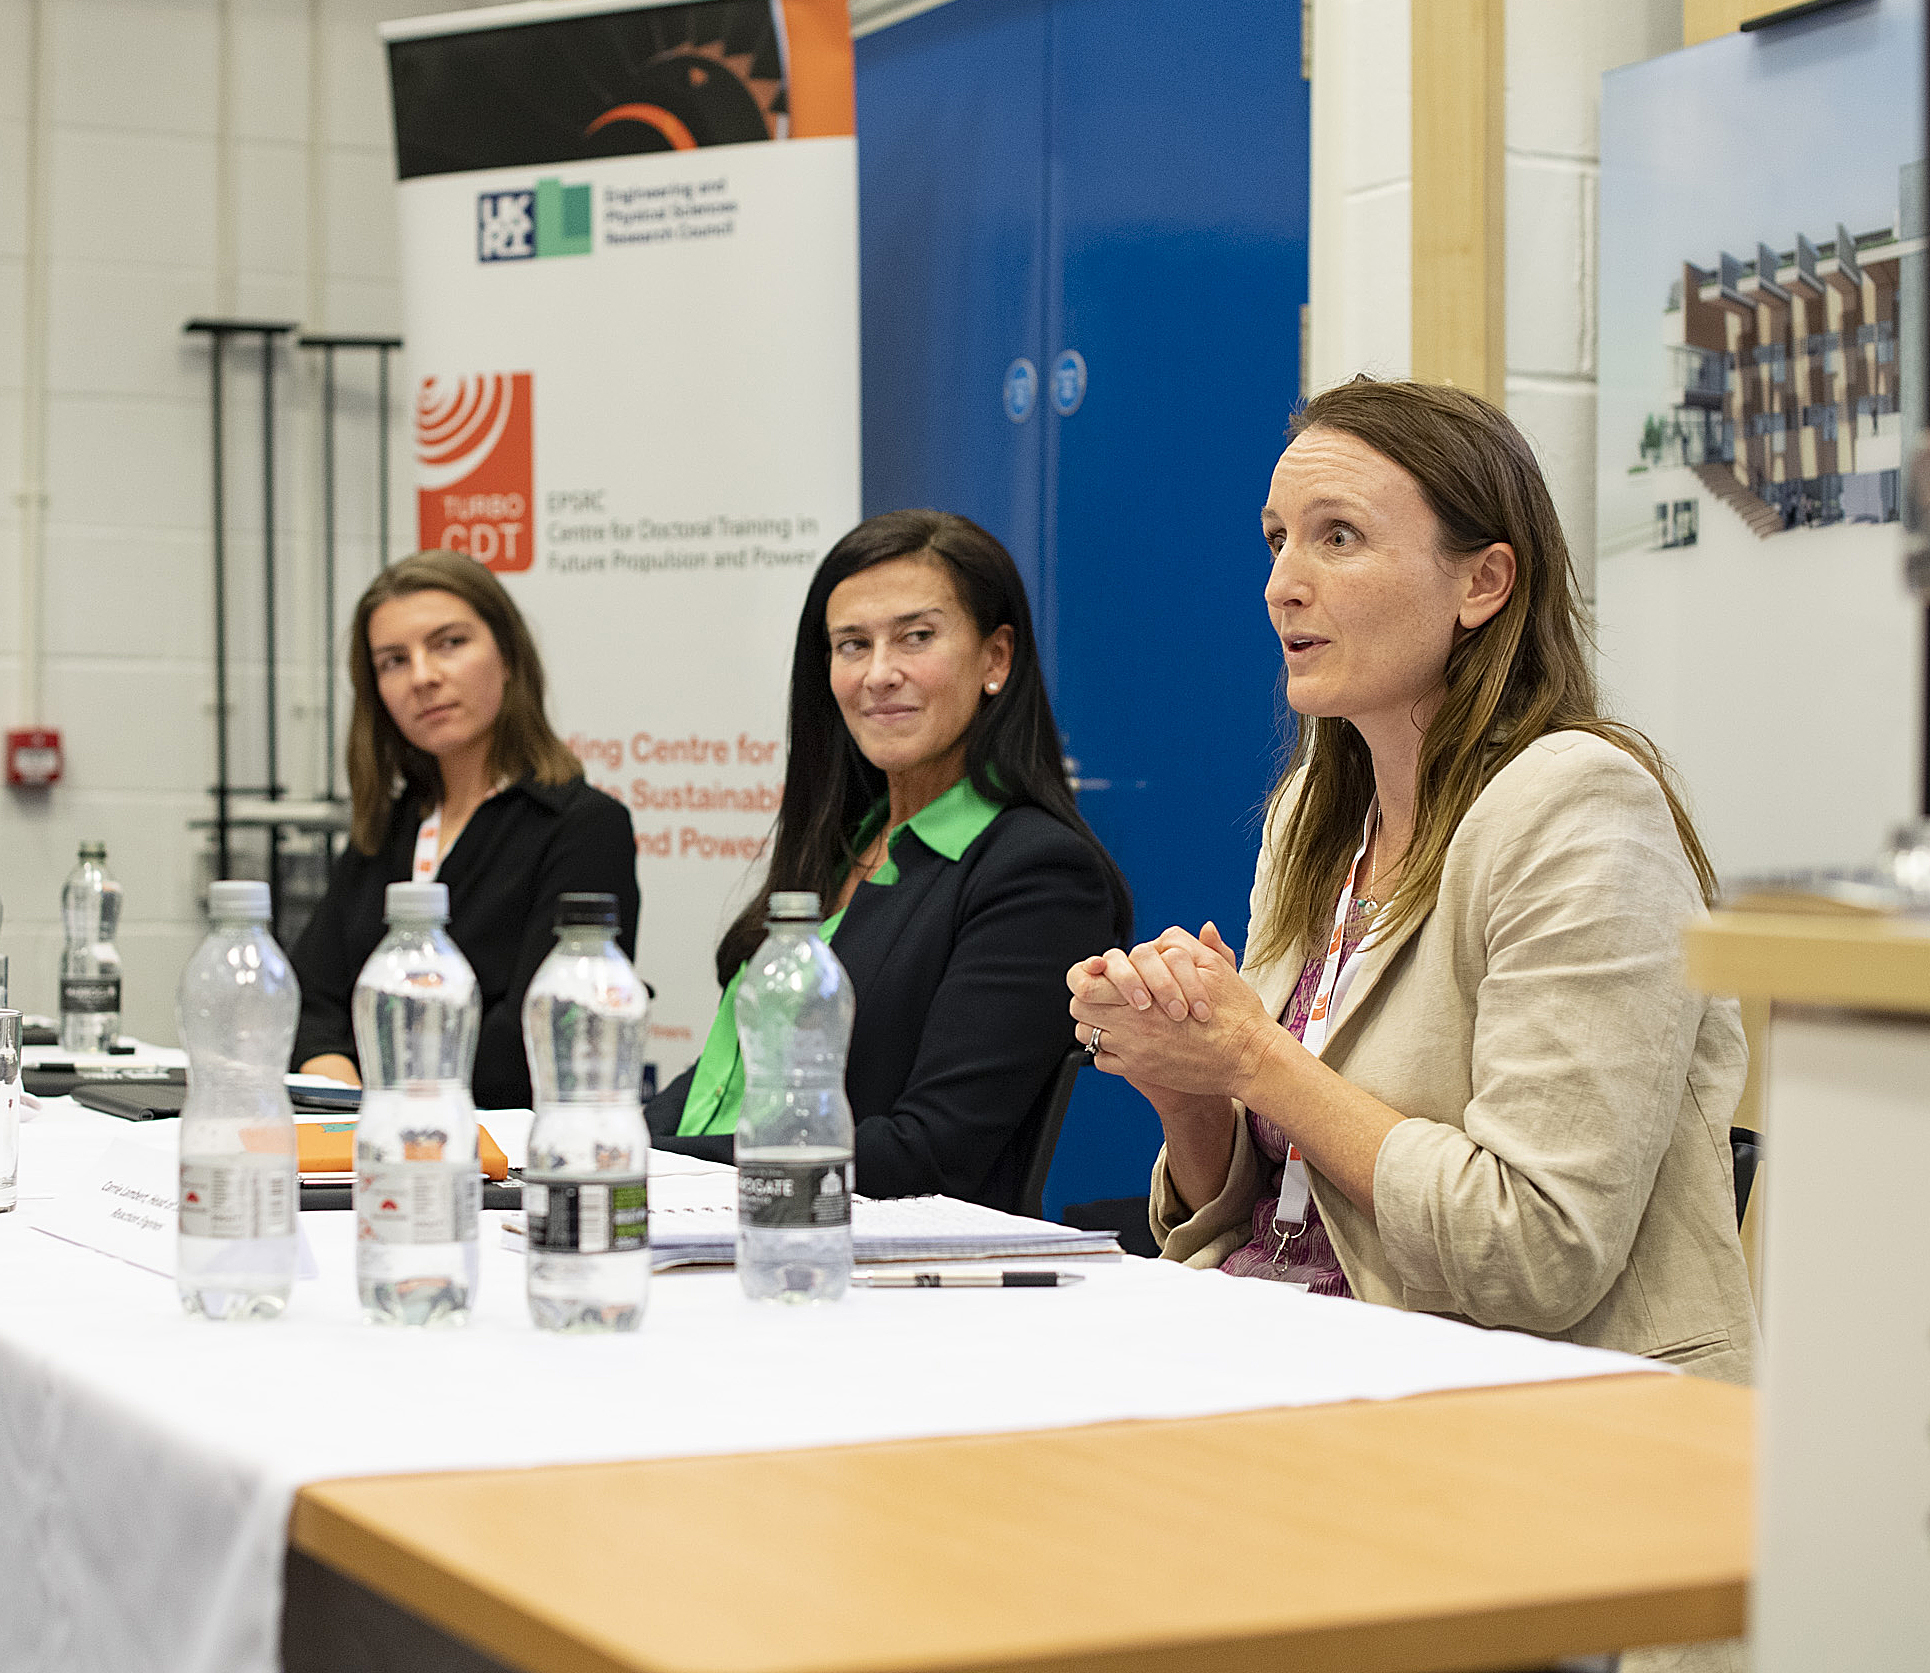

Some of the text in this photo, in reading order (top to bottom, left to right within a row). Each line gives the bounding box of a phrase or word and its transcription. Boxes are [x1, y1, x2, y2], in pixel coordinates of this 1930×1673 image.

[698, 178, 727, 192] and
[605, 220, 735, 244] Research Council
[444, 492, 526, 521] TURBO
[546, 520, 605, 542] Centre
[609, 517, 634, 539] for
[638, 518, 712, 540] Doctoral
[709, 514, 792, 541] Training
[441, 522, 523, 564] CDT
[546, 546, 818, 573] Future Propulsion and Power
[631, 731, 729, 765] Centre
[738, 731, 779, 765] for
[635, 827, 672, 858] nd
